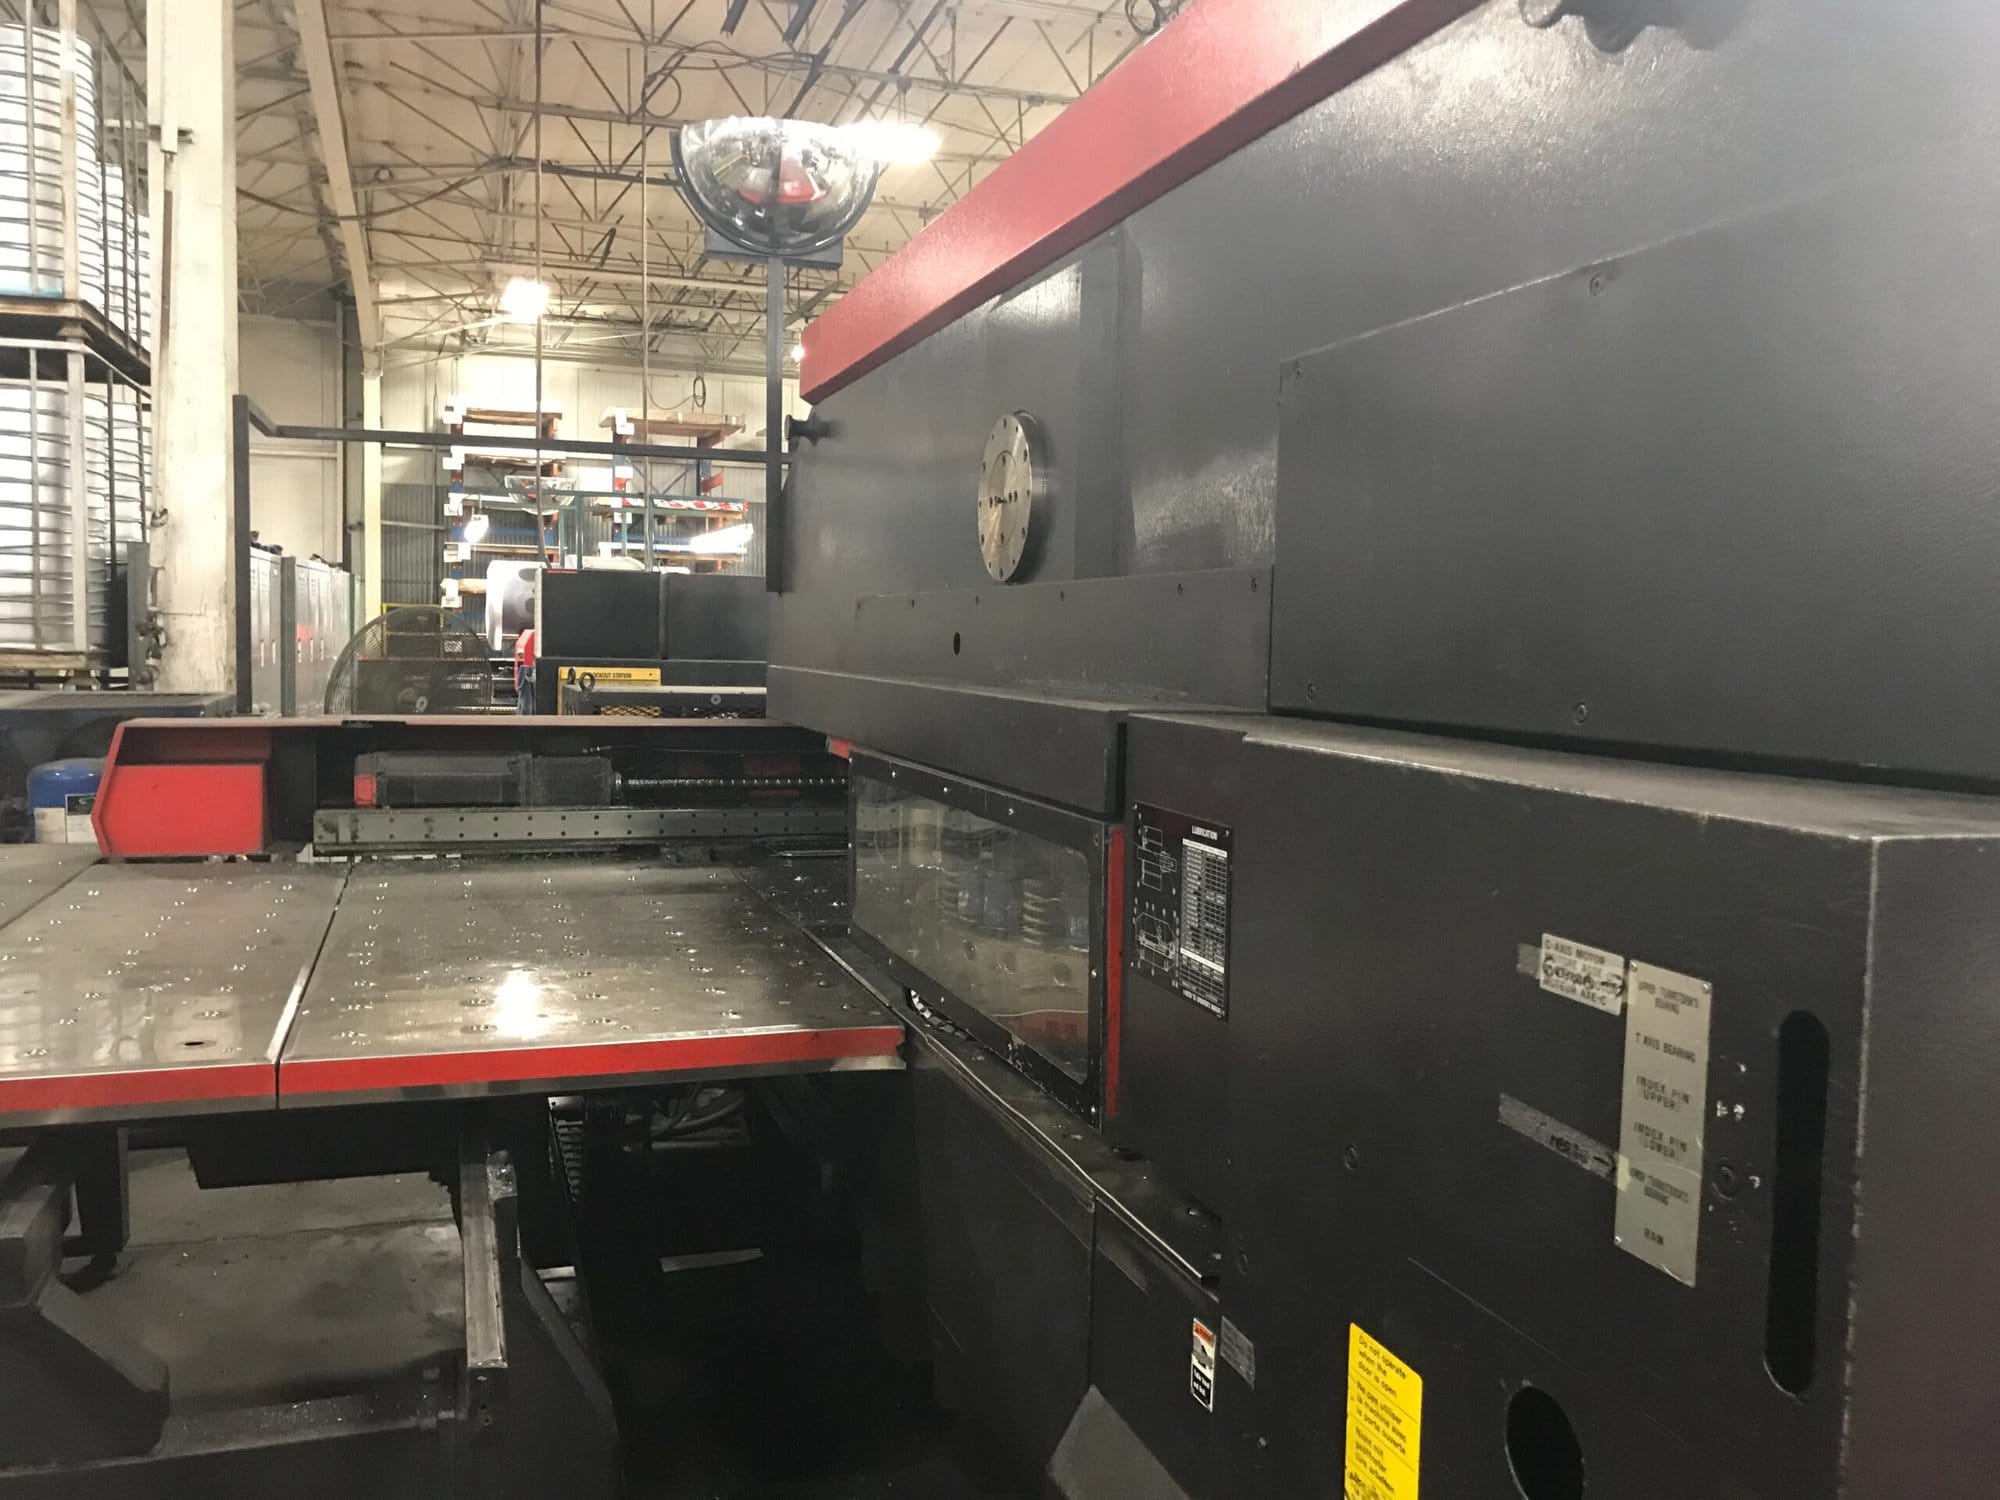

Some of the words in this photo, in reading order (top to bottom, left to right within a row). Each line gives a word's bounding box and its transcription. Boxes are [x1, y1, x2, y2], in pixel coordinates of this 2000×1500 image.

[1663, 1042, 1696, 1064] BEARING
[1358, 1350, 1375, 1367] when
[1376, 1361, 1387, 1377] the
[1359, 1334, 1368, 1348] Do
[1369, 1345, 1380, 1359] not
[1381, 1355, 1406, 1380] operate
[1358, 1361, 1372, 1376] door
[1381, 1381, 1397, 1399] open
